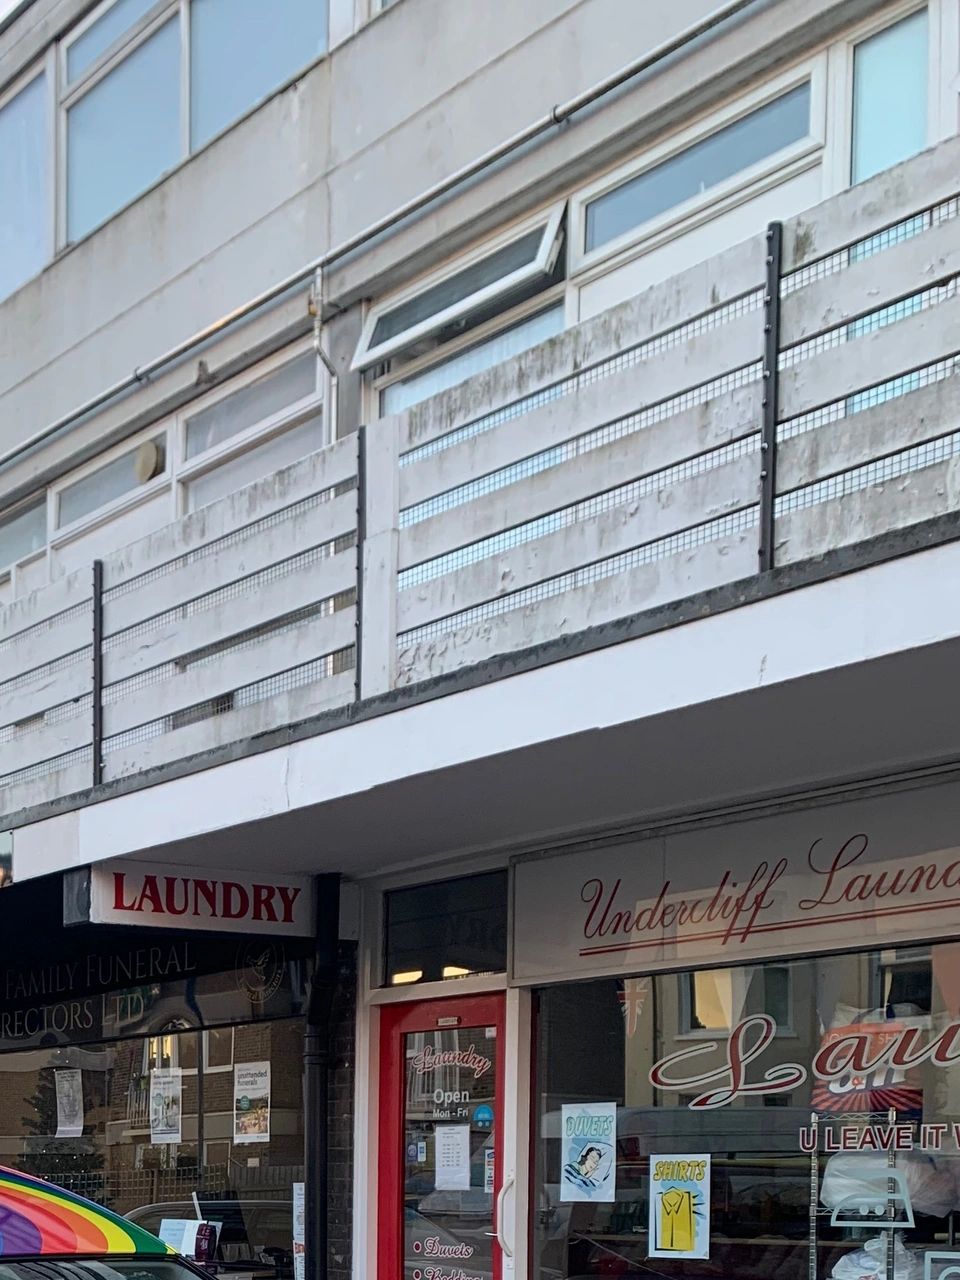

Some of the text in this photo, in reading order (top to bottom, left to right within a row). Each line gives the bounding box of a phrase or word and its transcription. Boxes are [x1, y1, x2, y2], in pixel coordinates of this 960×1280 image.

[113, 872, 302, 923] LAUNDRY
[581, 858, 788, 945] Undercliff
[5, 963, 78, 999] FAMILY
[87, 942, 197, 986] FUNERAL
[102, 993, 145, 1027] LTD
[412, 1044, 491, 1078] Laundry
[433, 1088, 470, 1107] Open
[432, 1108, 450, 1118] Mon
[457, 1108, 468, 1118] Fri
[566, 1115, 614, 1137] DUVETS
[799, 1126, 818, 1152] U
[824, 1124, 913, 1152] LEAVE
[920, 1123, 948, 1150] IT
[652, 1160, 707, 1182] SHIRTS
[424, 1237, 473, 1258] Duvets
